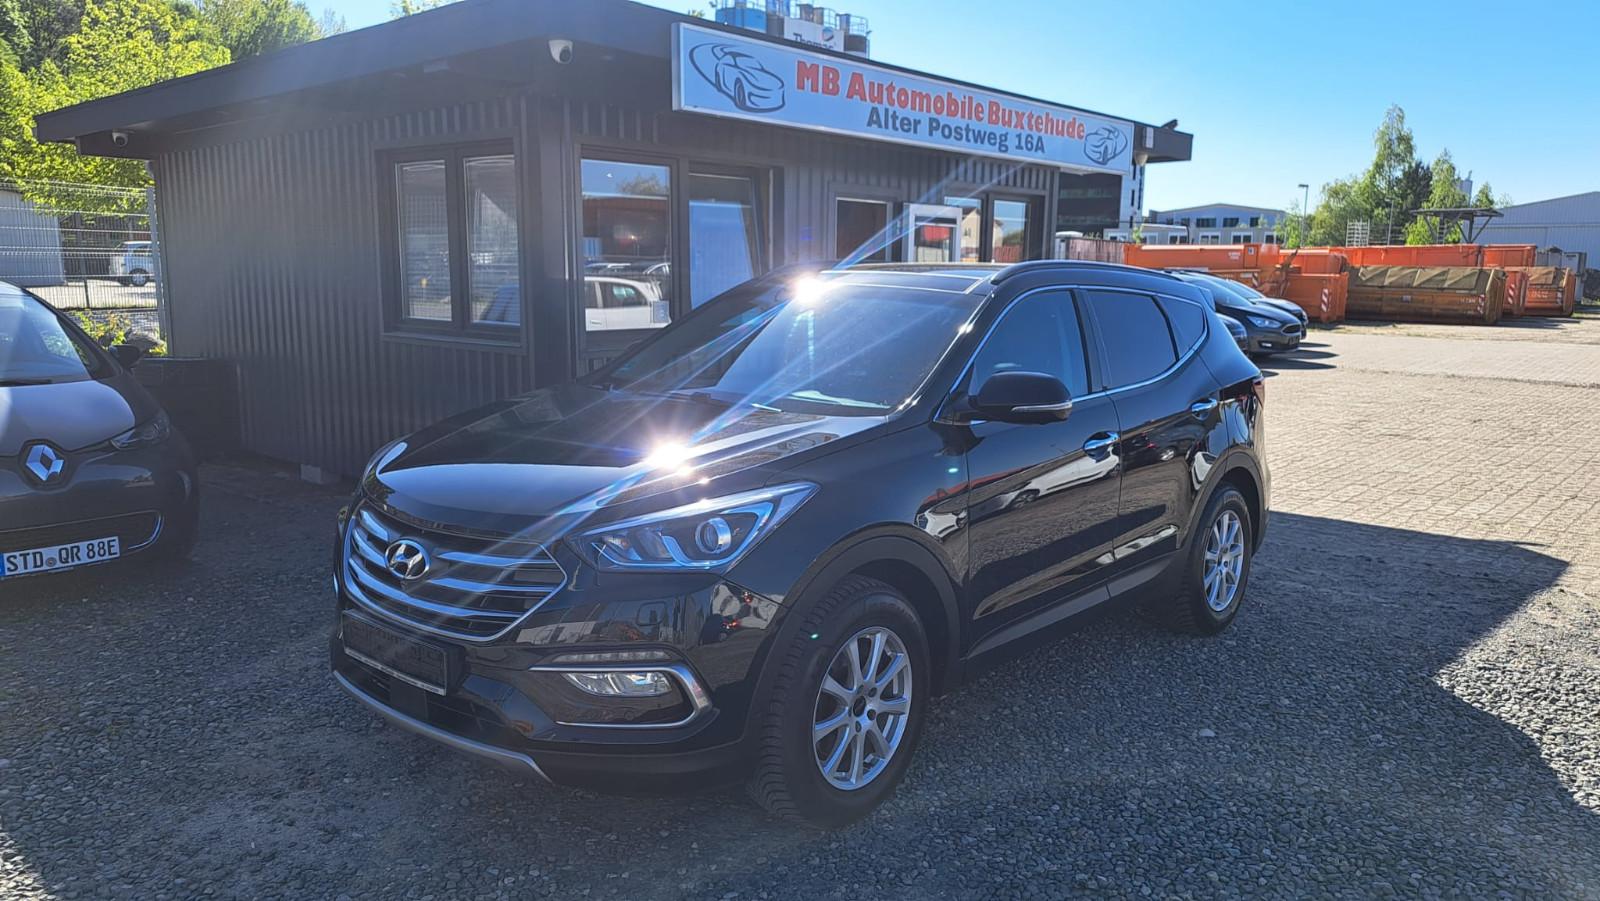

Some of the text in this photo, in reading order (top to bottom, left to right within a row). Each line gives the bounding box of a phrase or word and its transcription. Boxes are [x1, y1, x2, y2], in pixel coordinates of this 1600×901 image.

[796, 60, 1086, 141] MB Automobile Buxtehude
[866, 106, 1046, 154] Alter Postweg 16A
[6, 539, 118, 572] STD QR 88E
